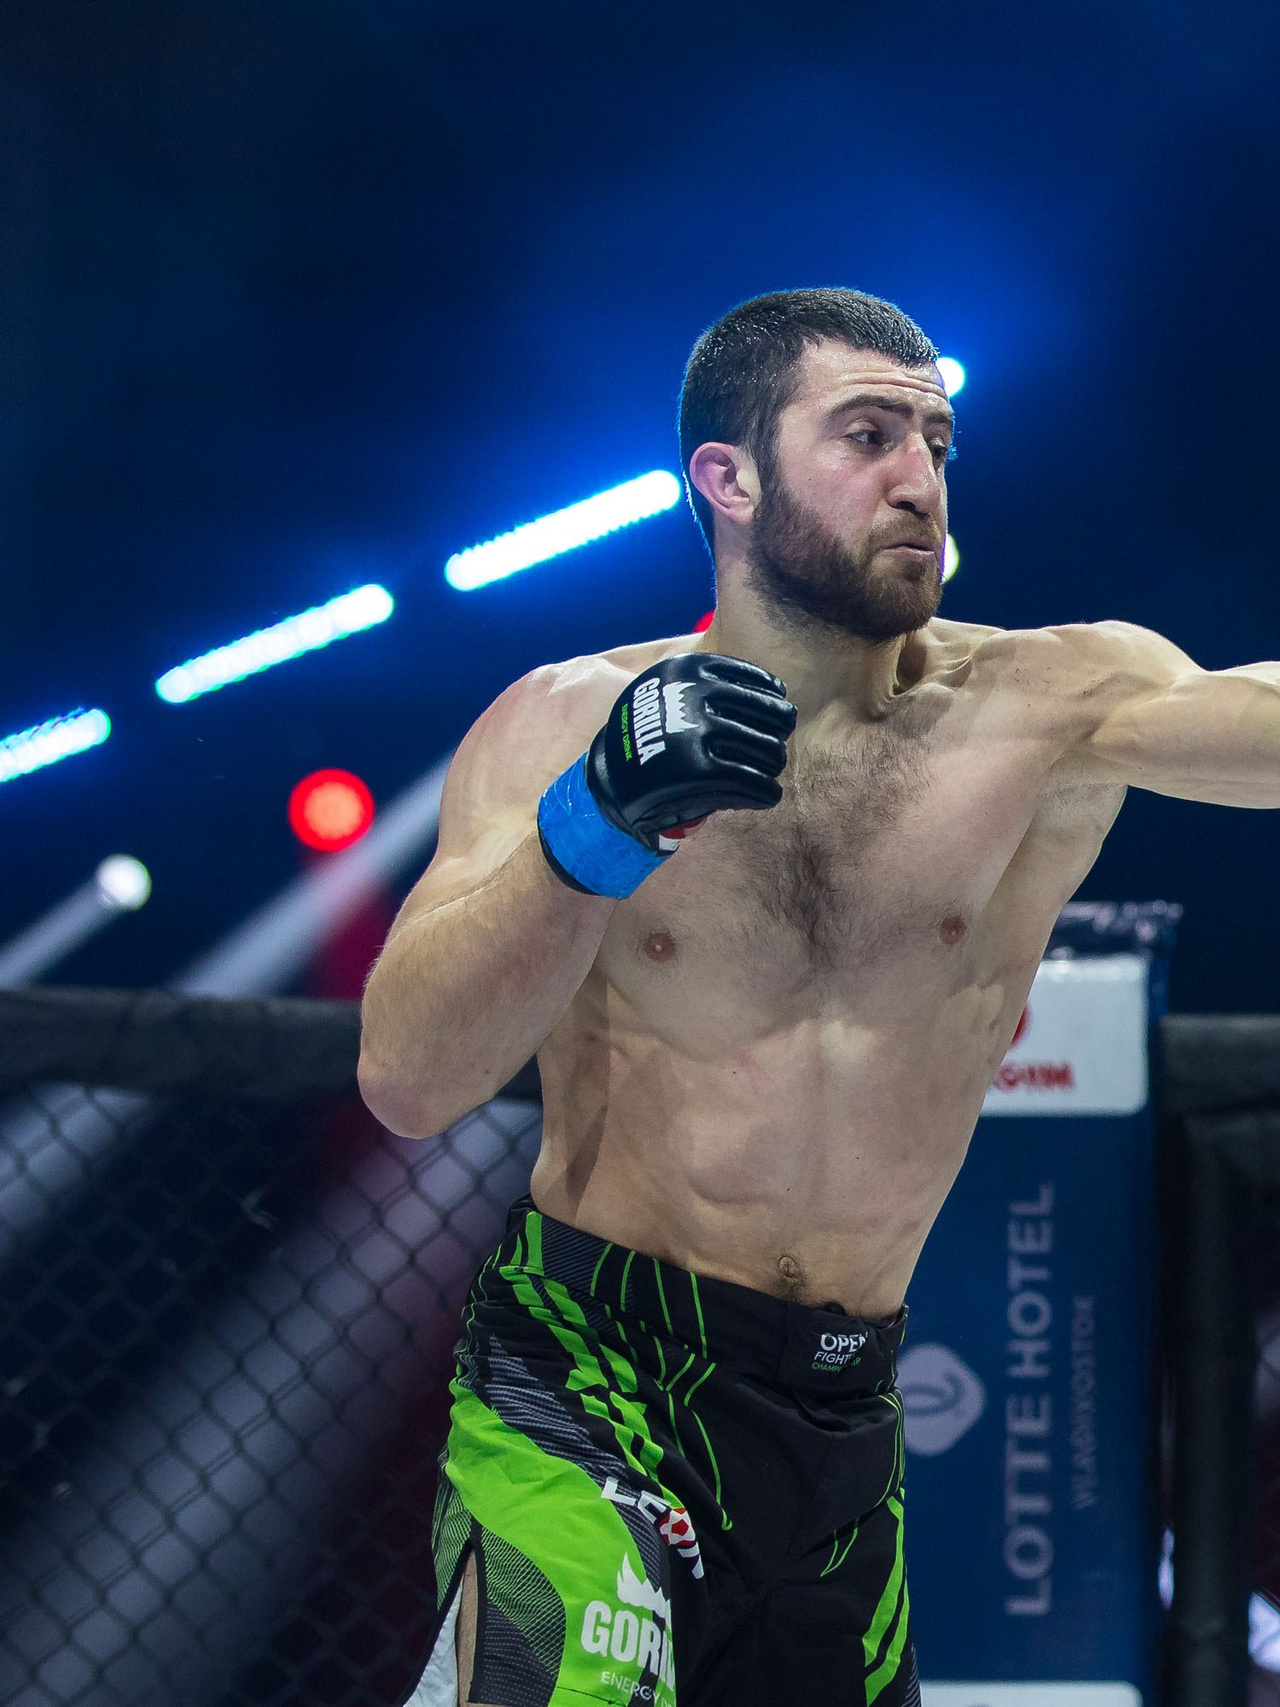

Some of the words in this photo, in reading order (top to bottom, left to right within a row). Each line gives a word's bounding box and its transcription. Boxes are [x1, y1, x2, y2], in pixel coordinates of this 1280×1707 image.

[632, 677, 666, 765] GORILLA
[1006, 1183, 1055, 1379] HOTEL
[1069, 1296, 1095, 1510] VLADIVOSTOK
[1004, 1394, 1054, 1616] LOTTE
[600, 1671, 660, 1704] ENERGY
